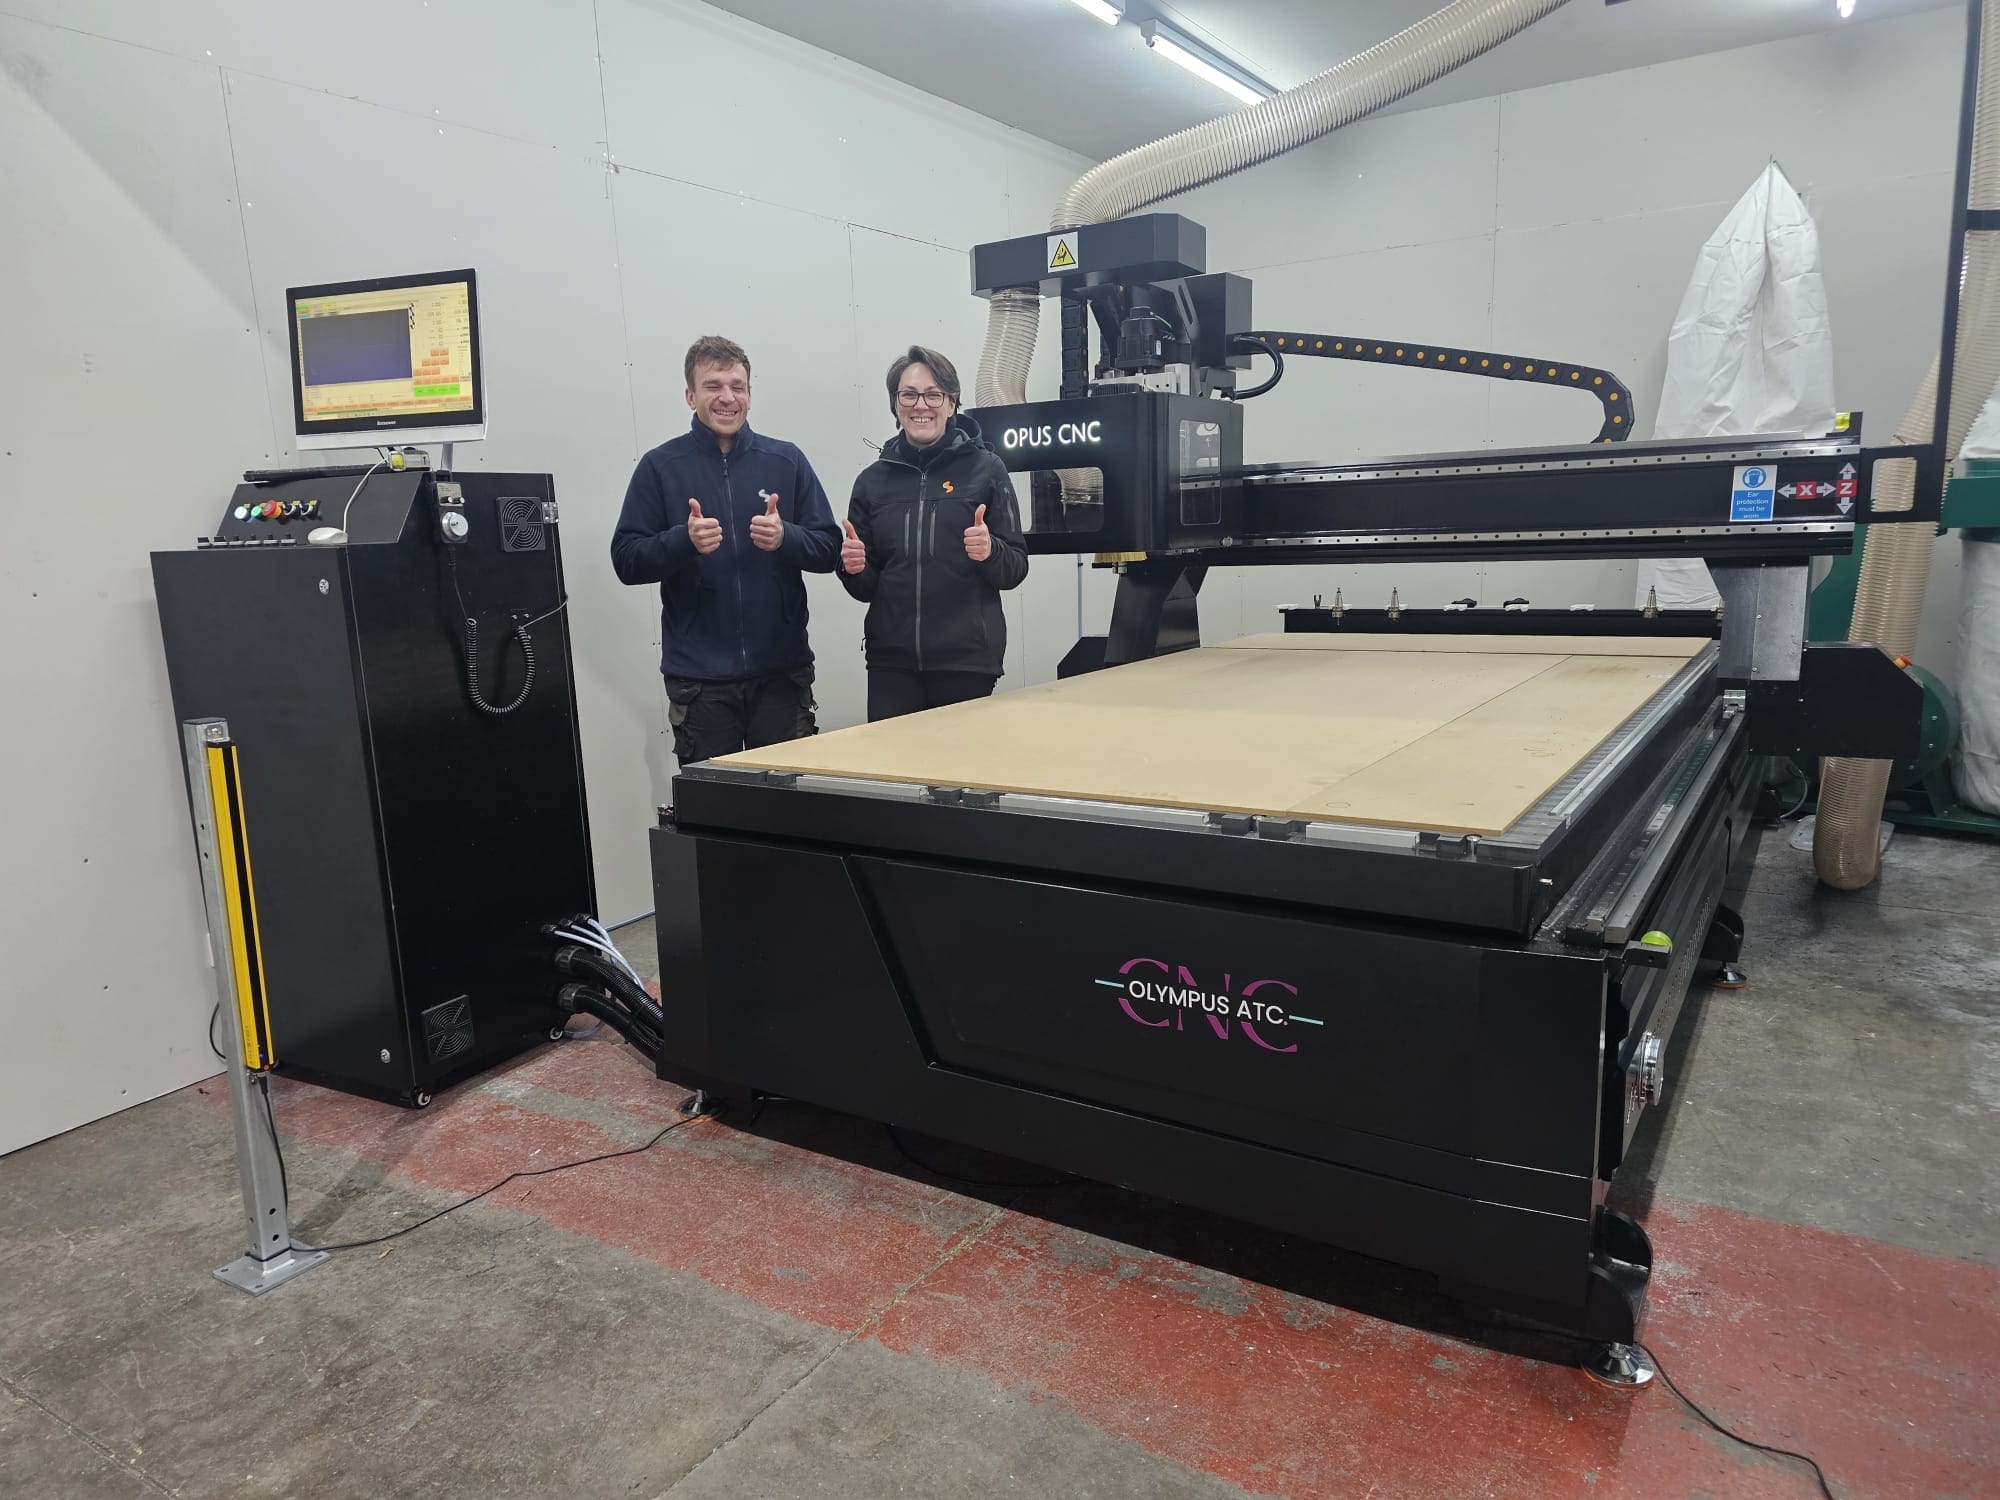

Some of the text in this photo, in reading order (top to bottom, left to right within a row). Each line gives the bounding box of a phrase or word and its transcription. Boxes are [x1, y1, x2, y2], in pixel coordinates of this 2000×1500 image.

[1003, 420, 1101, 449] OPUS CNC
[1799, 484, 1814, 497] X
[1840, 482, 1853, 495] Z
[1736, 498, 1769, 506] protection
[1118, 957, 1298, 1053] CNC
[1128, 979, 1230, 1015] OLYMPUS
